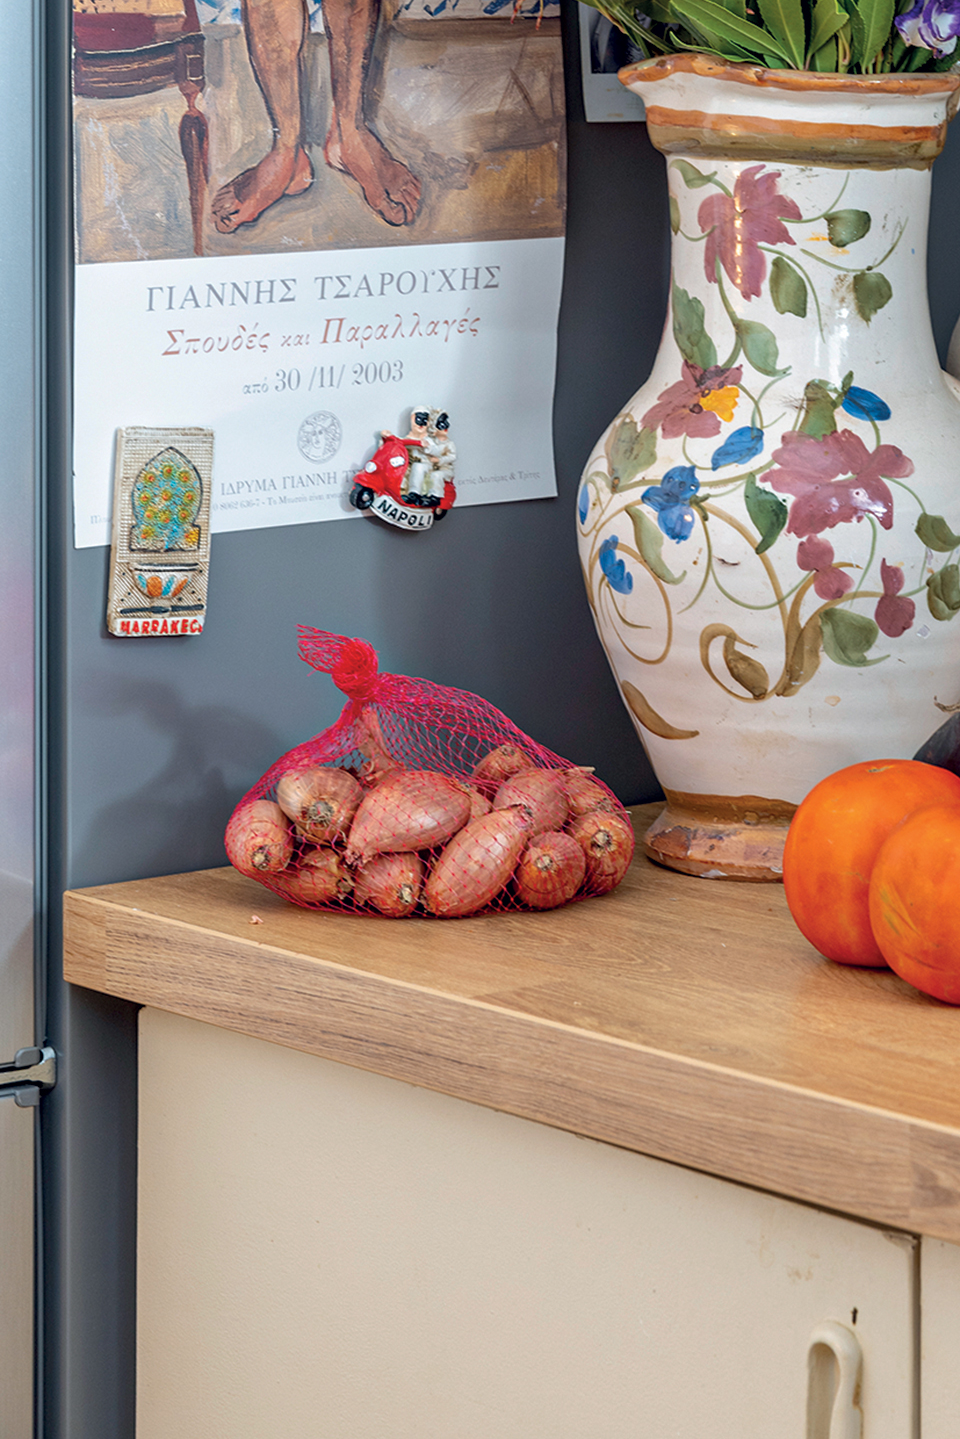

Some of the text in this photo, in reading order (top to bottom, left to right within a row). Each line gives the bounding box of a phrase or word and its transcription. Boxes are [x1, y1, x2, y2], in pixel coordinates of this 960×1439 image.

[146, 265, 501, 311] ΓΙΑΝΝΗΣ ΤΣΑΡΟΥΧΗΣ
[160, 307, 481, 356] Σπουδές και Παραλλαγές
[274, 368, 300, 392] 30
[352, 360, 405, 386] 2003
[221, 478, 277, 496] ΙΔΡΥΜΑ
[282, 472, 338, 490] ΓΙΑΝΝΗ
[377, 499, 432, 526] NAPOLI
